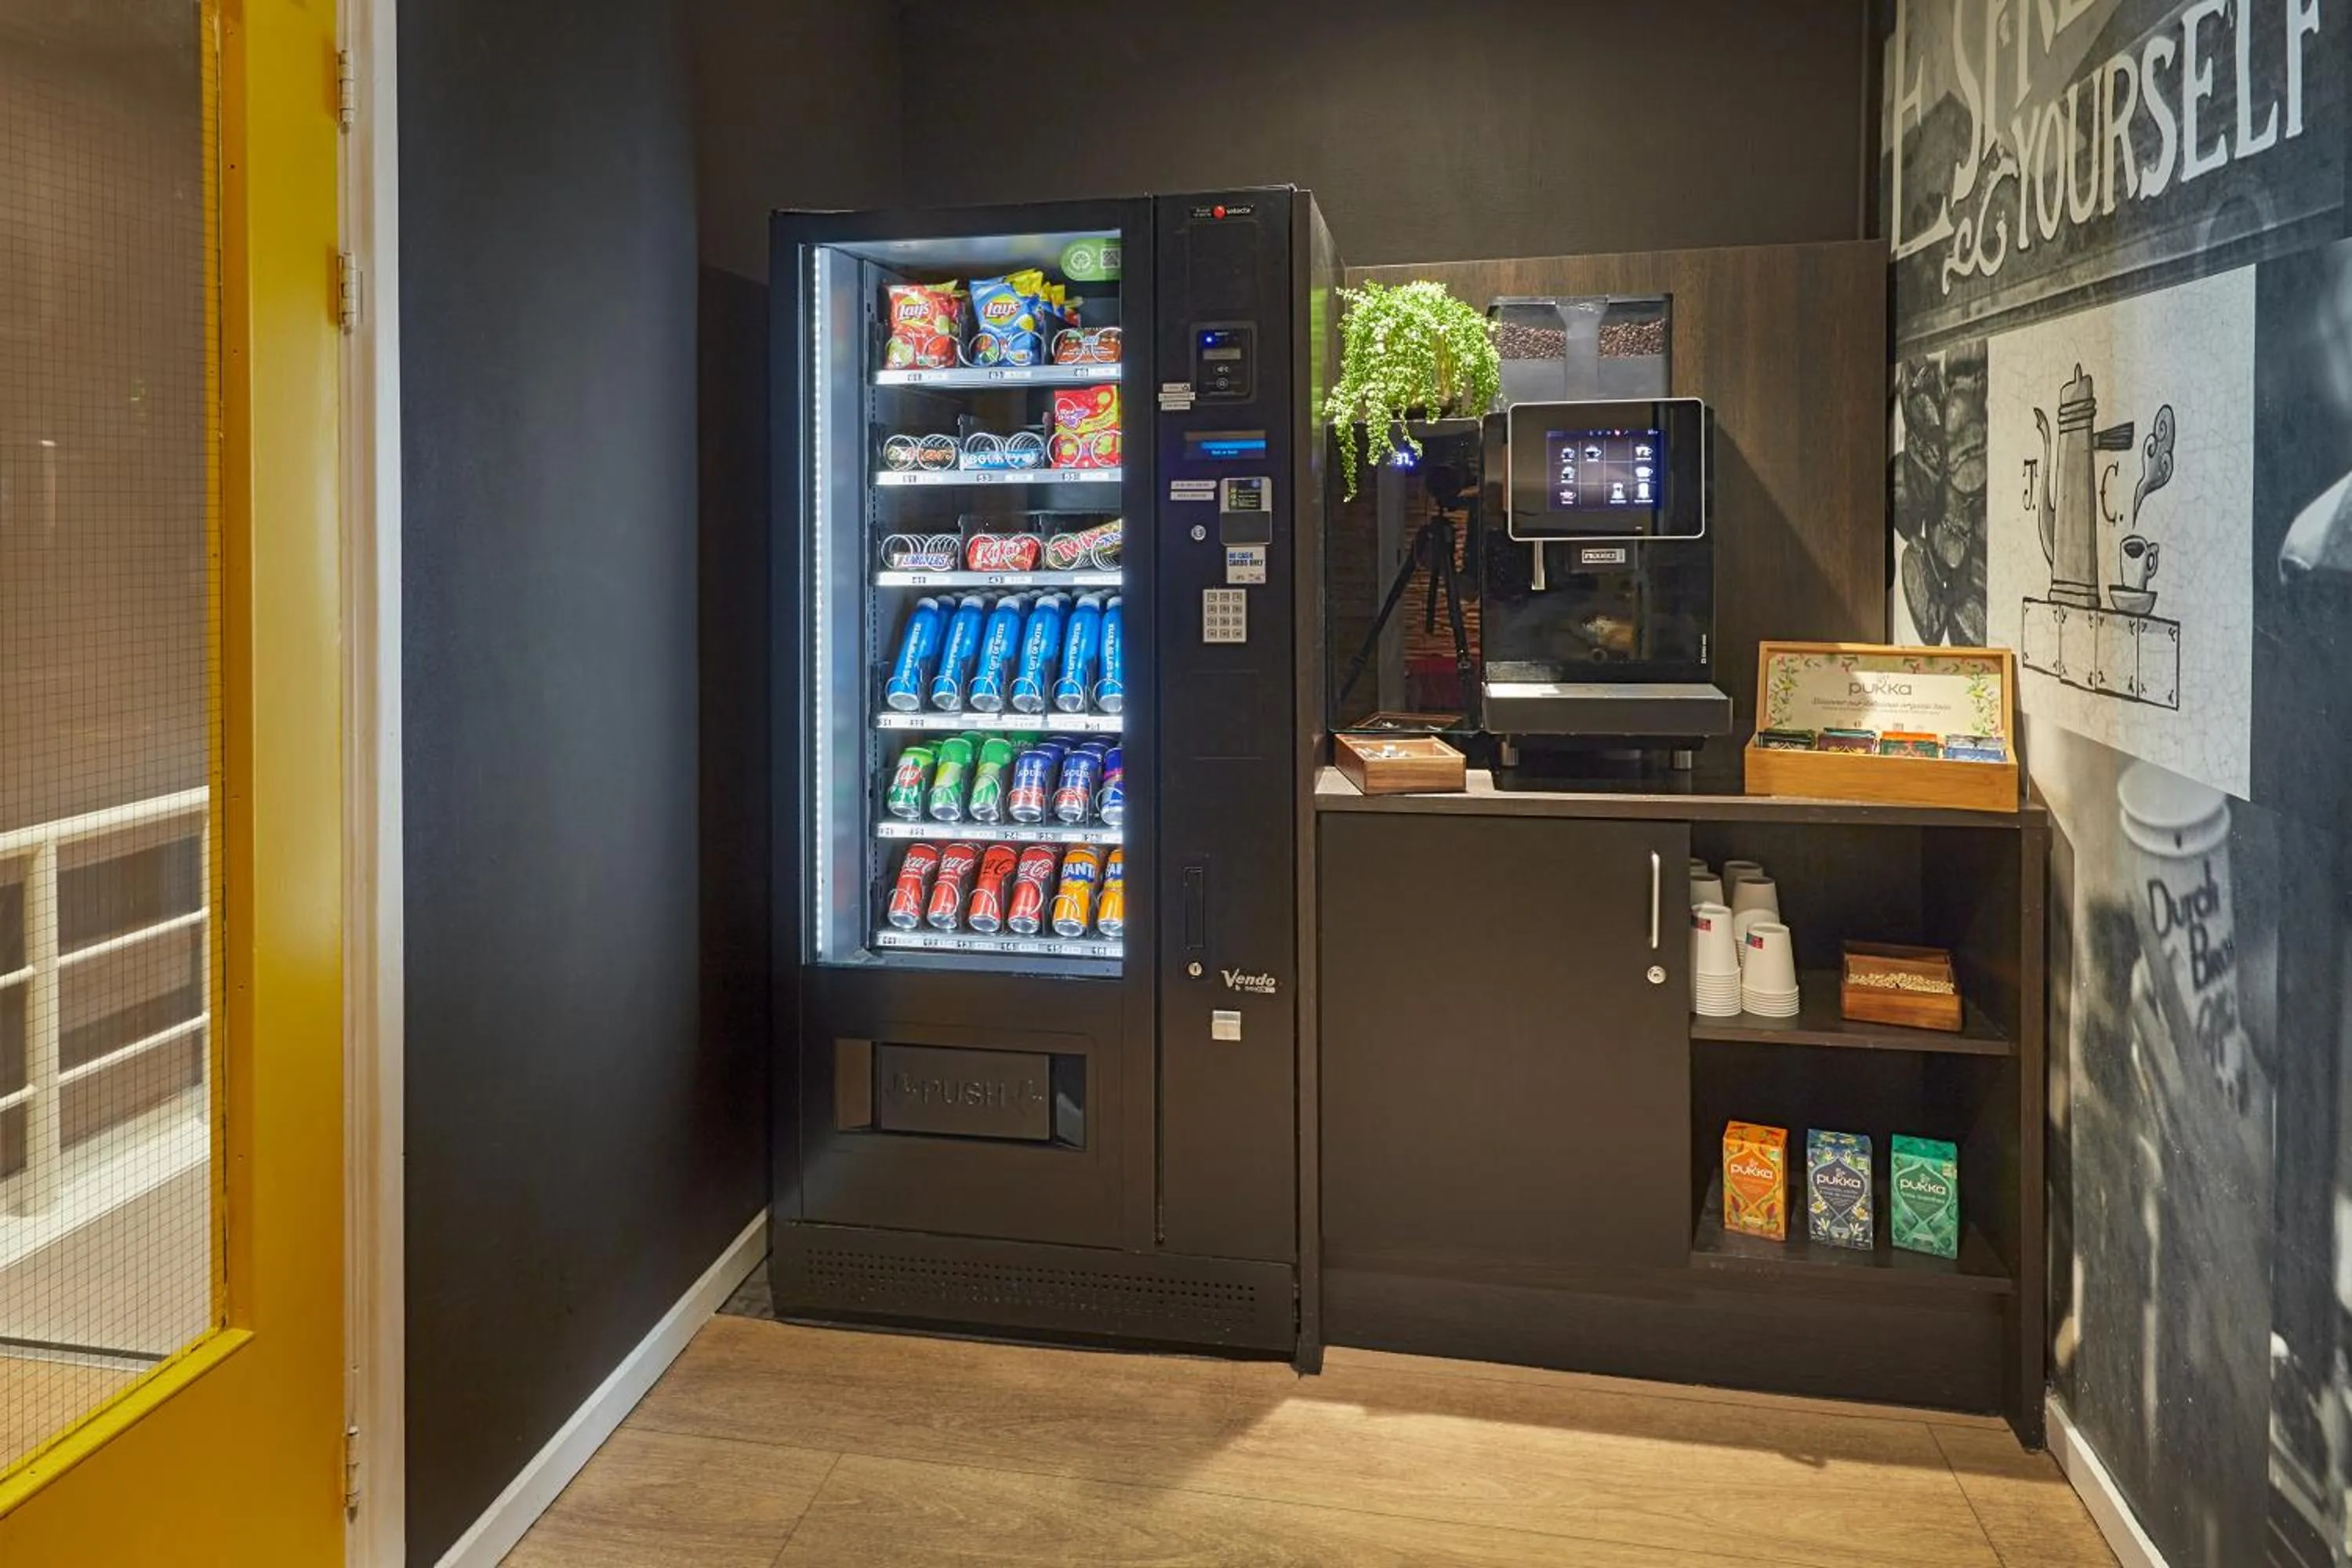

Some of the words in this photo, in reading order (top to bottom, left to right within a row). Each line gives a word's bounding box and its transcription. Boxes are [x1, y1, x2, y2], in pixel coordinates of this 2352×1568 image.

[2010, 0, 2320, 251] YOURSELF
[1848, 680, 1912, 696] pukka
[1061, 862, 1095, 879] FANT
[1221, 968, 1276, 988] Vendo
[920, 1077, 1007, 1109] PUSH
[1730, 1163, 1773, 1180] pukka
[1817, 1172, 1861, 1189] pukka
[1899, 1178, 1946, 1196] pukka
